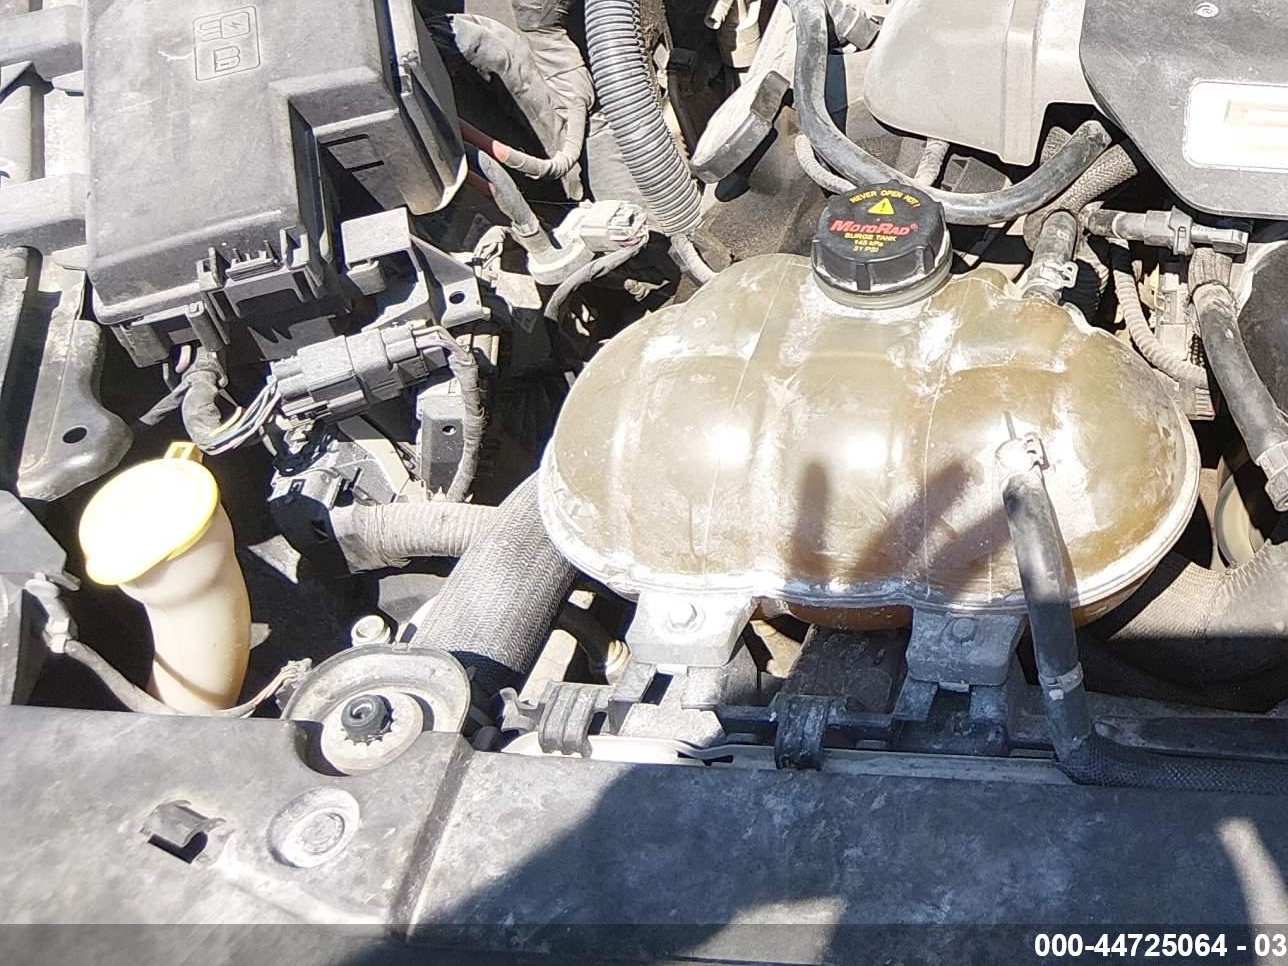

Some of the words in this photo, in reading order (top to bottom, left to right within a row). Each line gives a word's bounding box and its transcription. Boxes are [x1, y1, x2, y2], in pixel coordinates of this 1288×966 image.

[848, 190, 878, 203] NEVER
[879, 189, 904, 200] OPEN
[844, 232, 874, 240] SURGE
